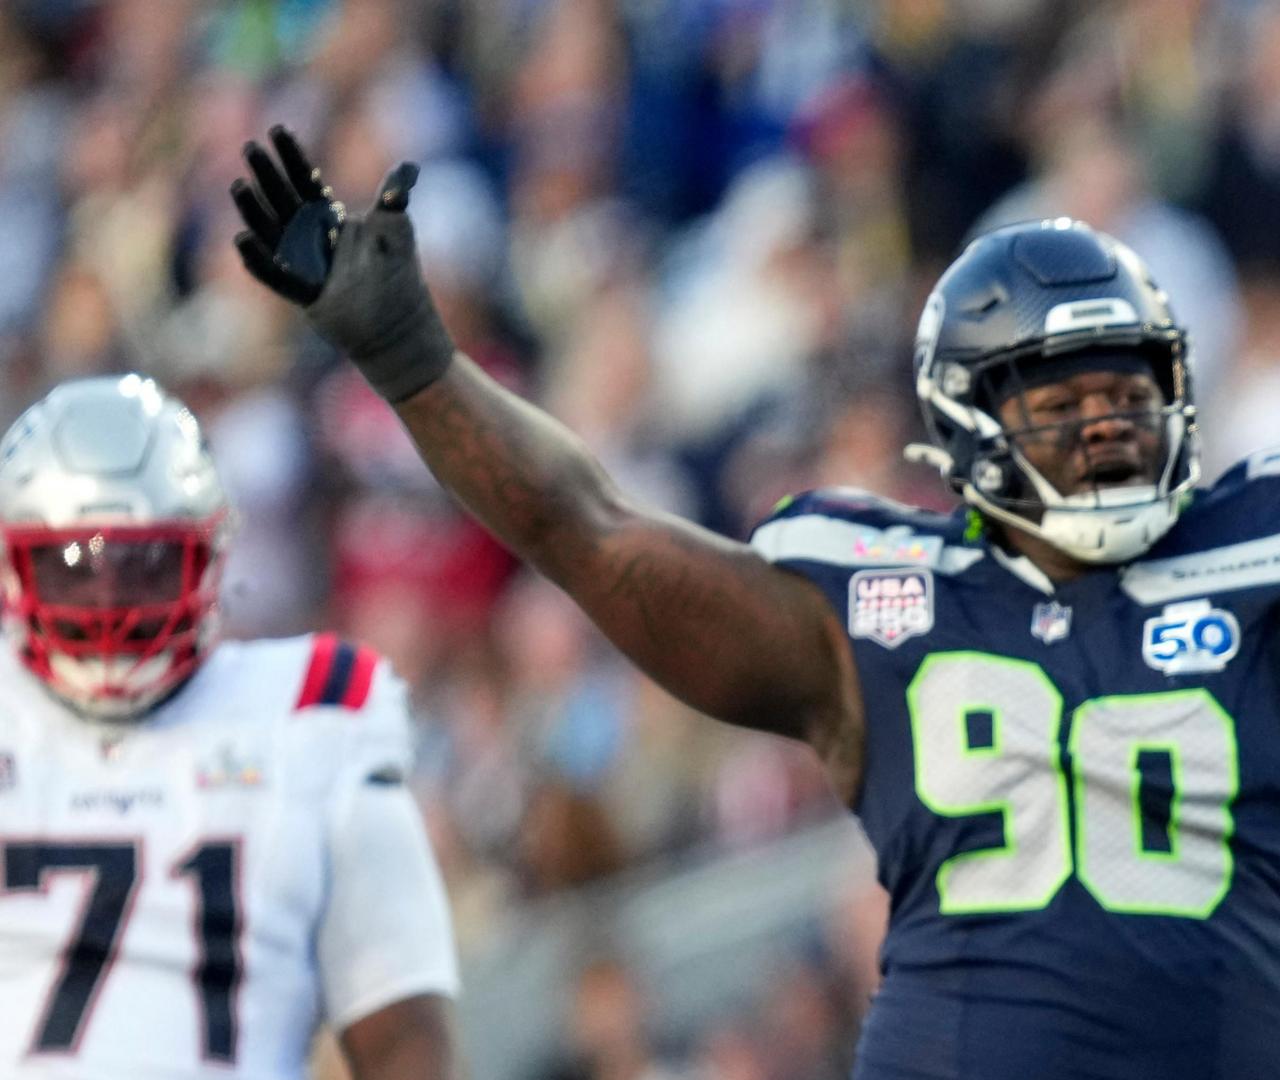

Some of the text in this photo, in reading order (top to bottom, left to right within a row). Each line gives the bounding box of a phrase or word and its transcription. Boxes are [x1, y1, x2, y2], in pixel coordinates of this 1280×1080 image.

[1151, 614, 1233, 661] 50
[907, 650, 1239, 919] 90
[0, 834, 248, 1068] 71
